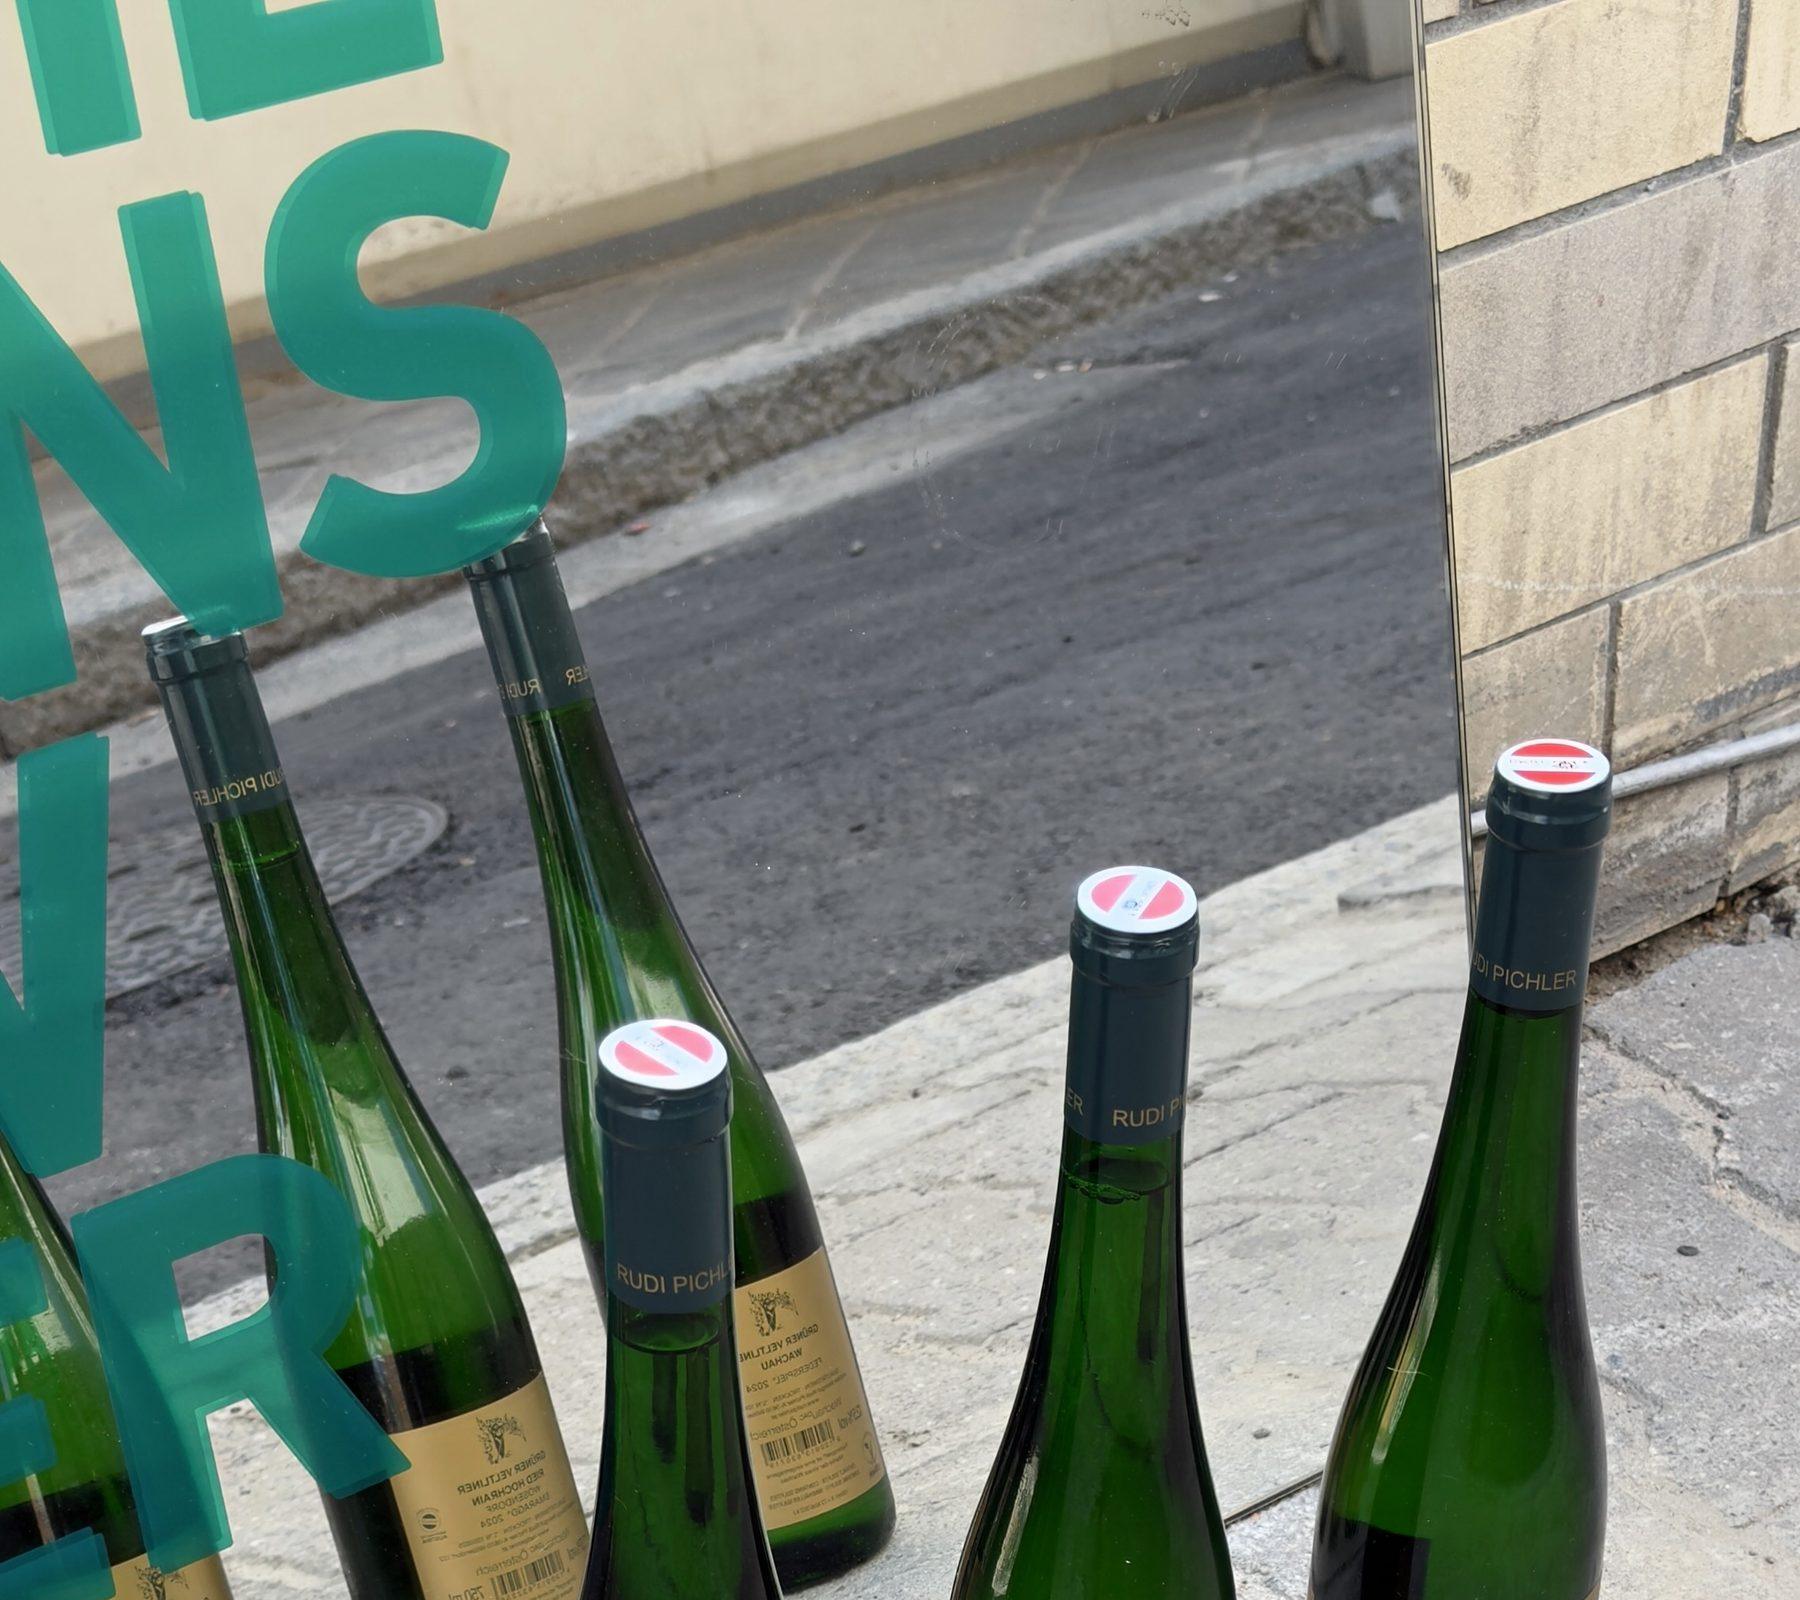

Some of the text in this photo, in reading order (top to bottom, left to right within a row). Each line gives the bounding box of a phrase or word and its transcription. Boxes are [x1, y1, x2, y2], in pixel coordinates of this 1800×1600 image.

[1493, 964, 1576, 992] PICHLER
[1112, 1105, 1165, 1128] RUDI
[617, 1262, 665, 1293] RUDI
